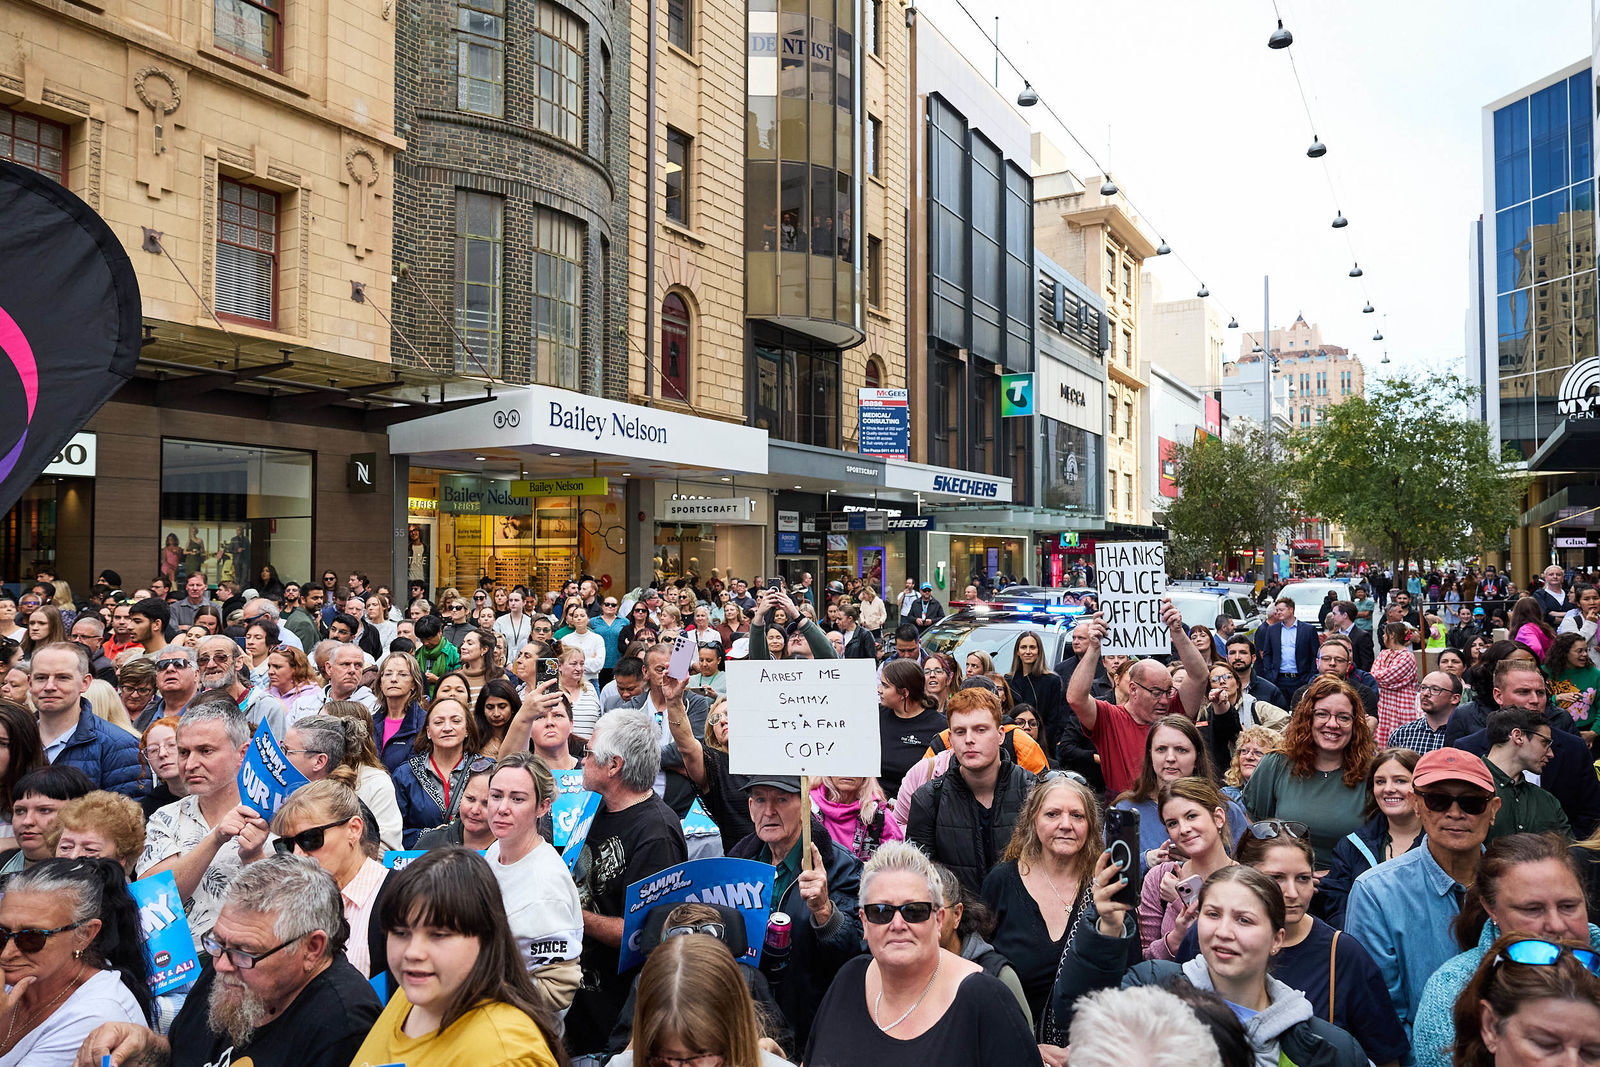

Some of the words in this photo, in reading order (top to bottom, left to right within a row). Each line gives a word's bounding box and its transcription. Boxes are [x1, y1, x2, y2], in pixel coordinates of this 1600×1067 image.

[751, 36, 833, 61] DENTIST
[1060, 383, 1086, 407] MECCA
[550, 402, 606, 440] Bailey
[612, 412, 667, 444] Nelson
[846, 466, 878, 476] SPORTSCRAFT
[444, 486, 484, 504] Bailey
[488, 489, 529, 506] Nelson
[529, 480, 553, 494] Bailey
[555, 480, 584, 492] Nelson
[932, 475, 998, 497] SKECHERS
[672, 505, 738, 514] SPORTSCRAFT
[1098, 546, 1164, 568] THANKS
[1098, 570, 1162, 594] POLICE
[1102, 626, 1170, 648] SAMMY
[760, 668, 804, 682] ARREST
[819, 669, 841, 680] ME
[768, 718, 796, 730] IT'S
[802, 720, 810, 728] A
[817, 719, 846, 729] FAIR
[784, 742, 835, 758] COP!
[242, 760, 270, 810] OUR
[640, 870, 685, 899] SAMMY
[530, 940, 568, 956] SINCE
[175, 960, 195, 976] ALI
